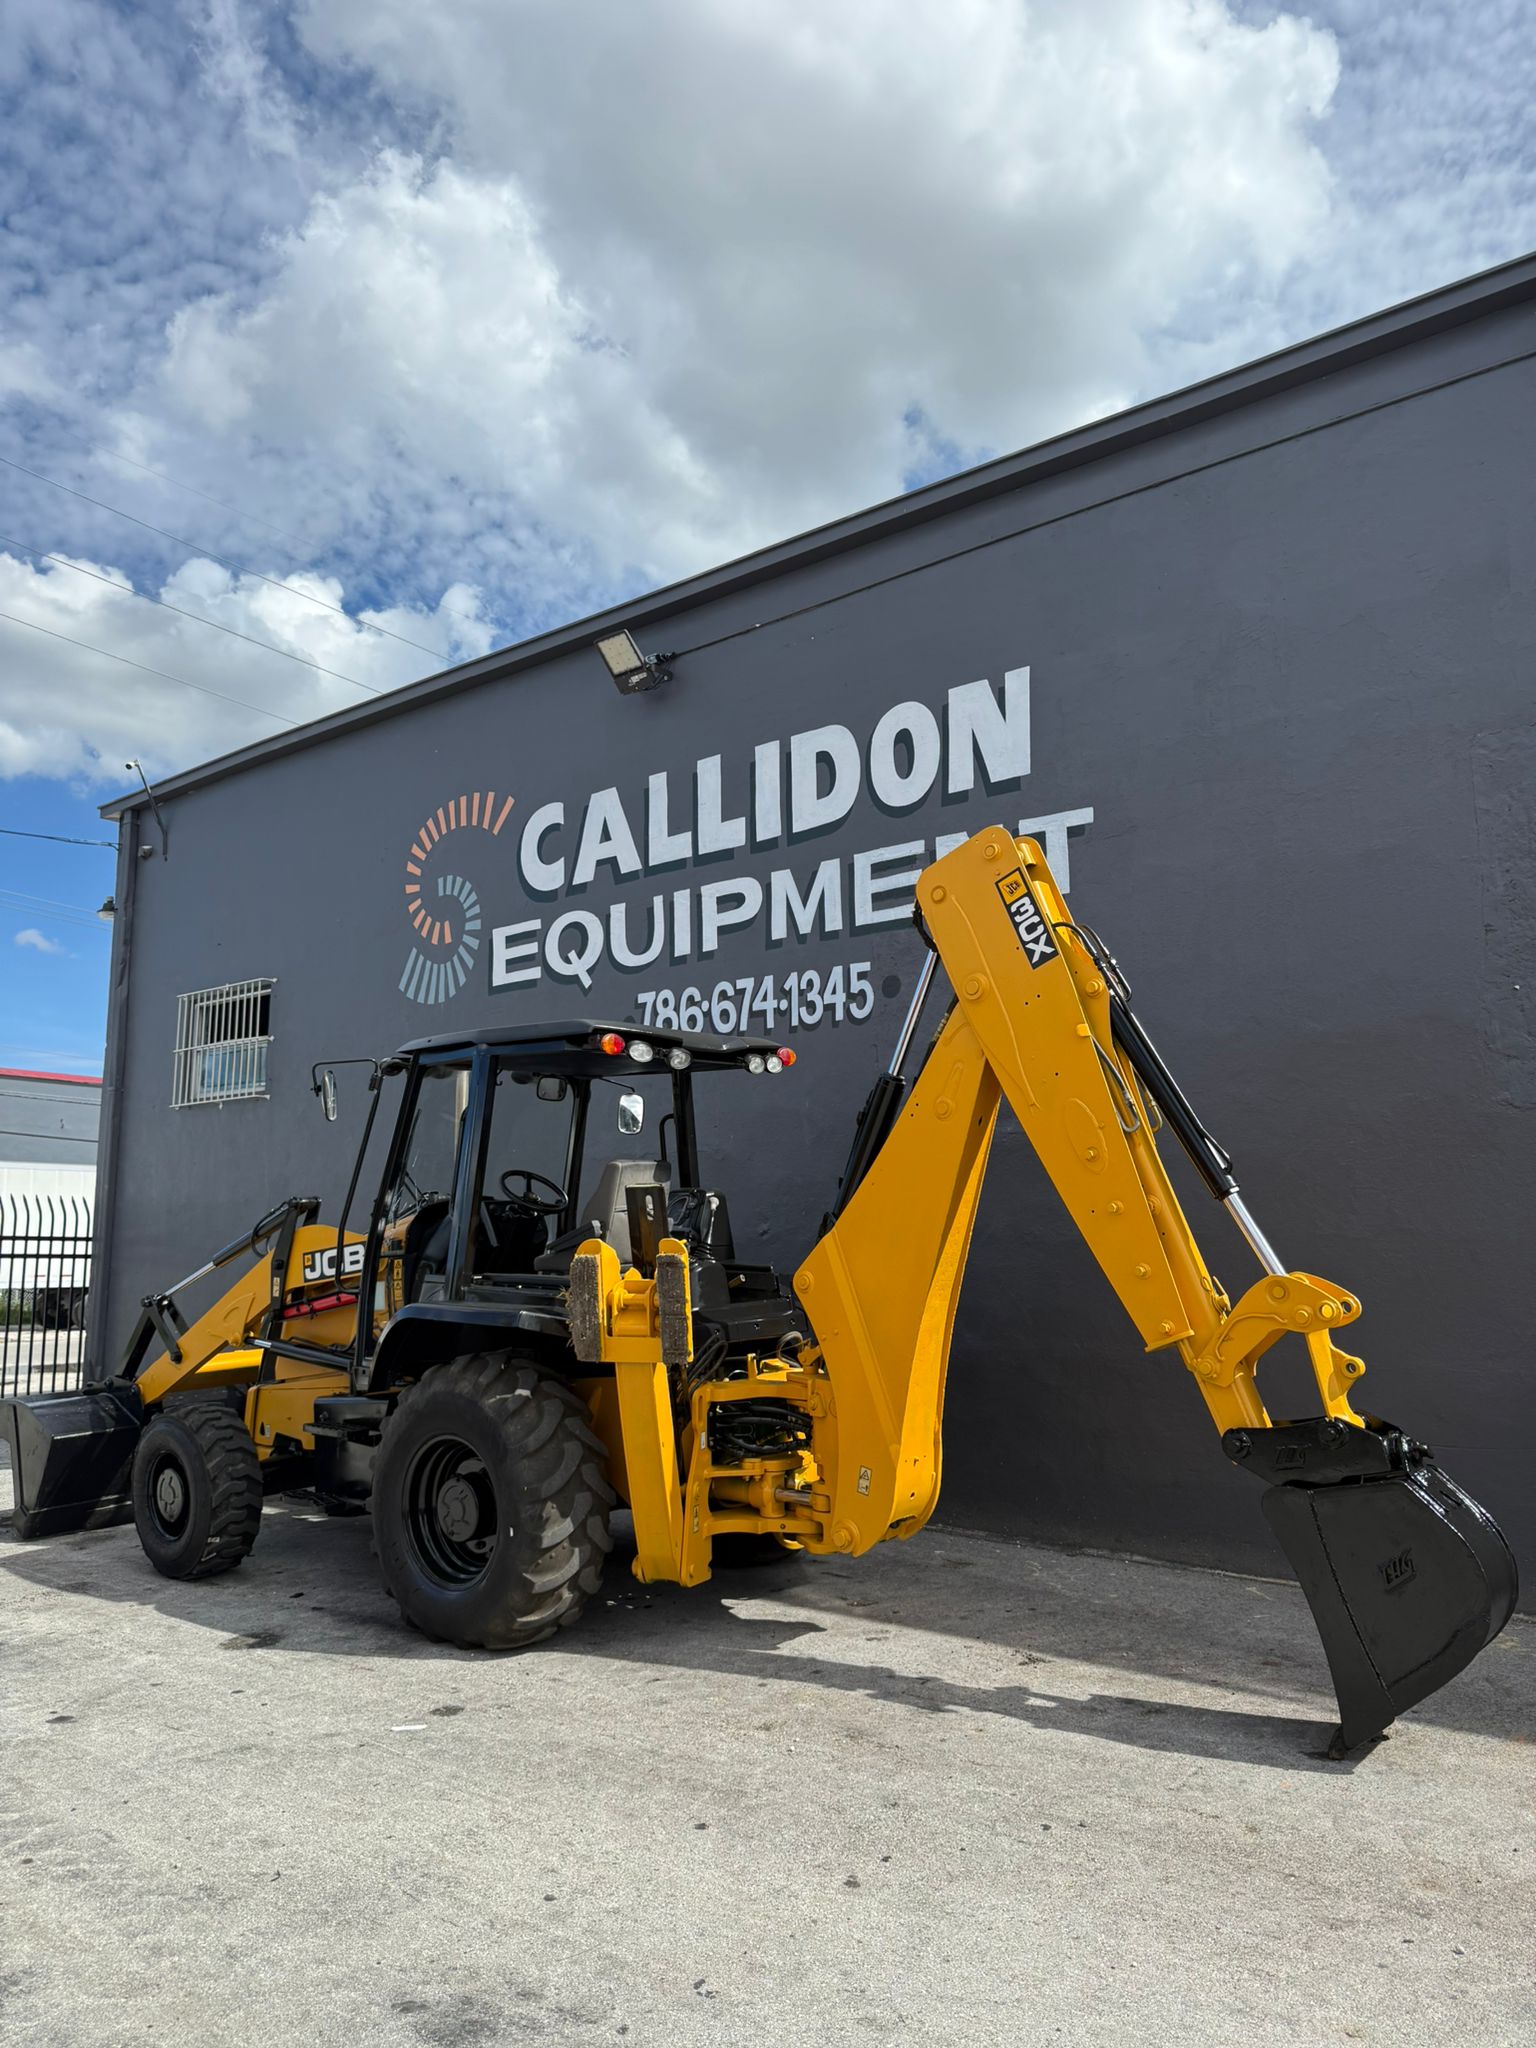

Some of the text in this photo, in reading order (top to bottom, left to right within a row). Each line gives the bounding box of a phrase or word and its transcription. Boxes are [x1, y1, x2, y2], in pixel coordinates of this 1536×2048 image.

[520, 665, 1031, 892] CALLIDON
[492, 806, 1094, 989] EQUIPMET
[1010, 896, 1056, 964] 3CX
[304, 1243, 366, 1280] JCB
